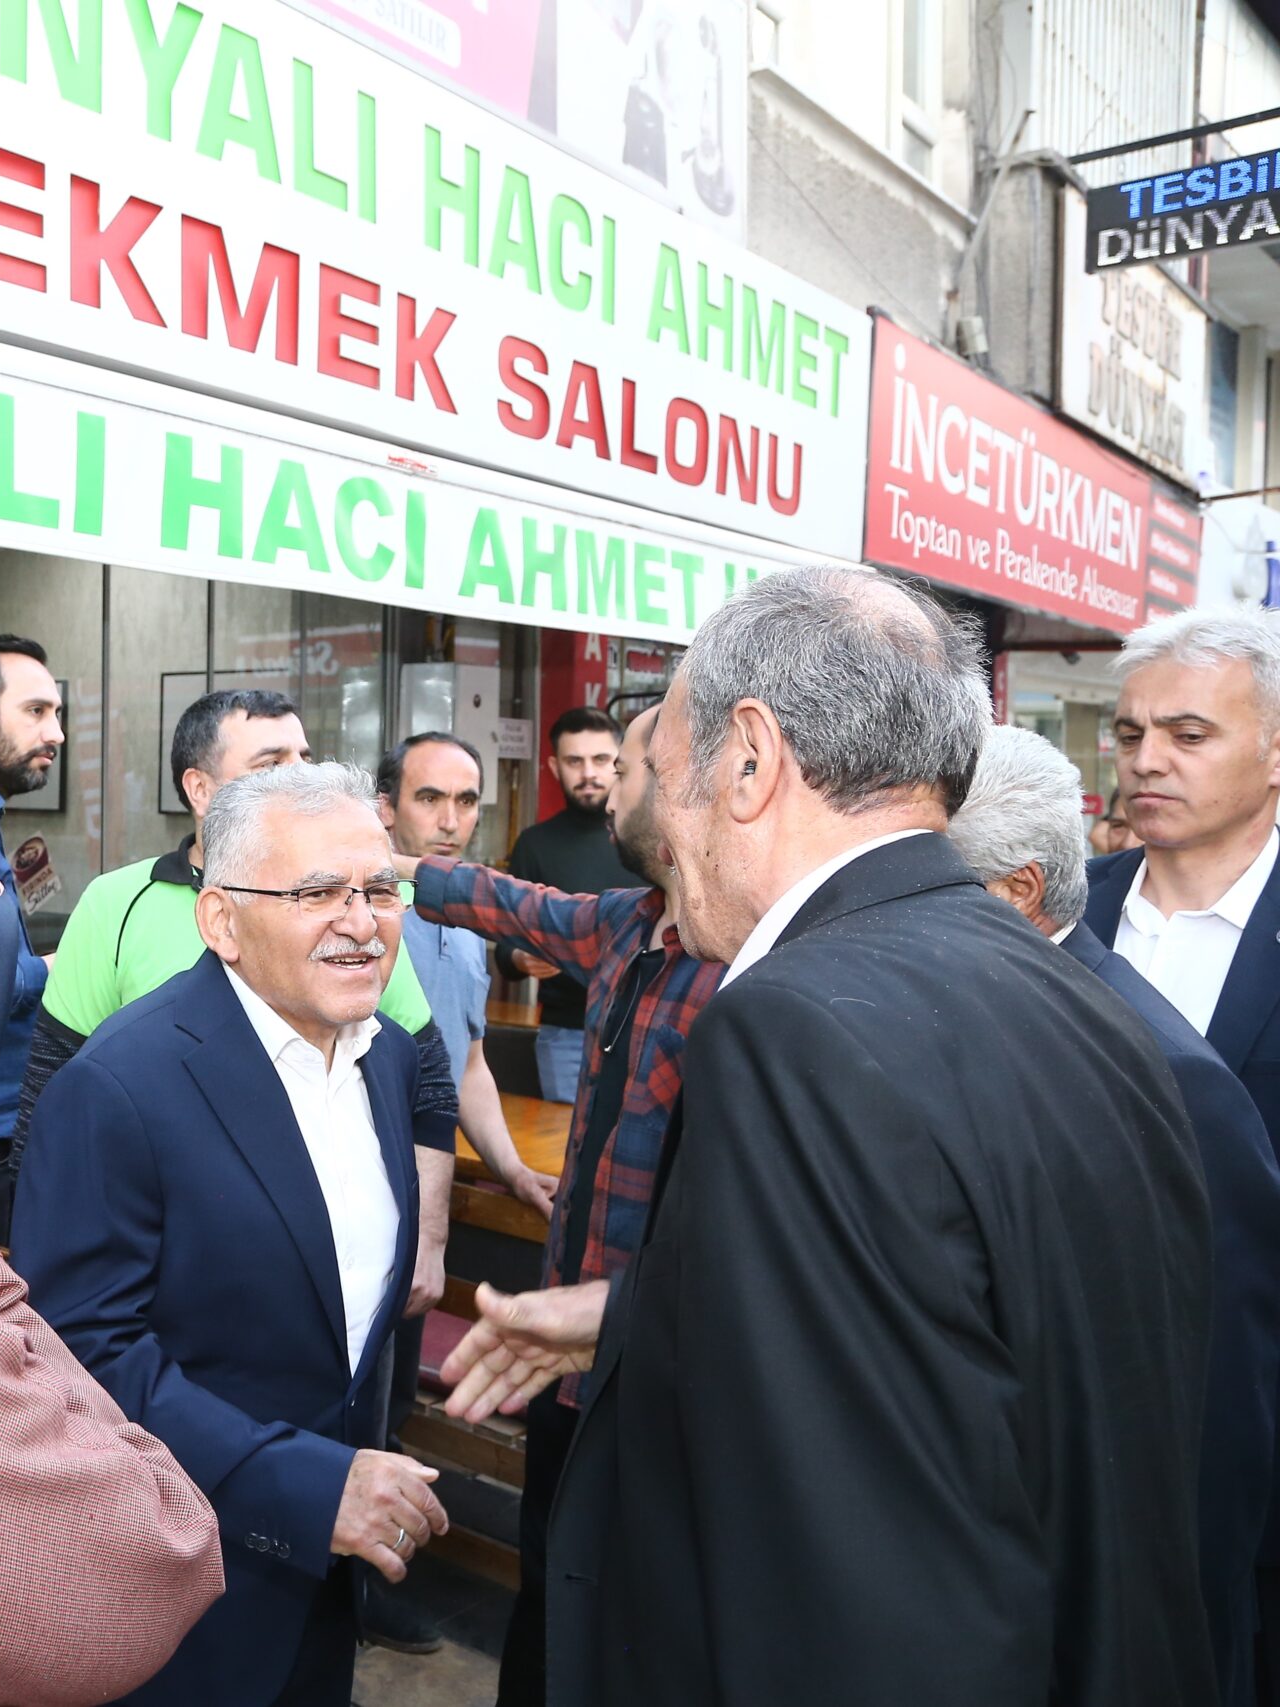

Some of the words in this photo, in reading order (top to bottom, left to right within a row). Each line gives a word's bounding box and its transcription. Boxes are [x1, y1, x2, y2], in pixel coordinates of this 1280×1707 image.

[424, 125, 616, 325] HACI
[646, 243, 849, 417] AHMET
[497, 336, 802, 516] SALONU
[889, 343, 1142, 572] İNCETÜRKMEN
[160, 432, 427, 590] HACI
[458, 507, 704, 630] AHMET
[884, 483, 962, 560] Toptan
[967, 534, 991, 571] ve
[995, 527, 1078, 602] Perakende
